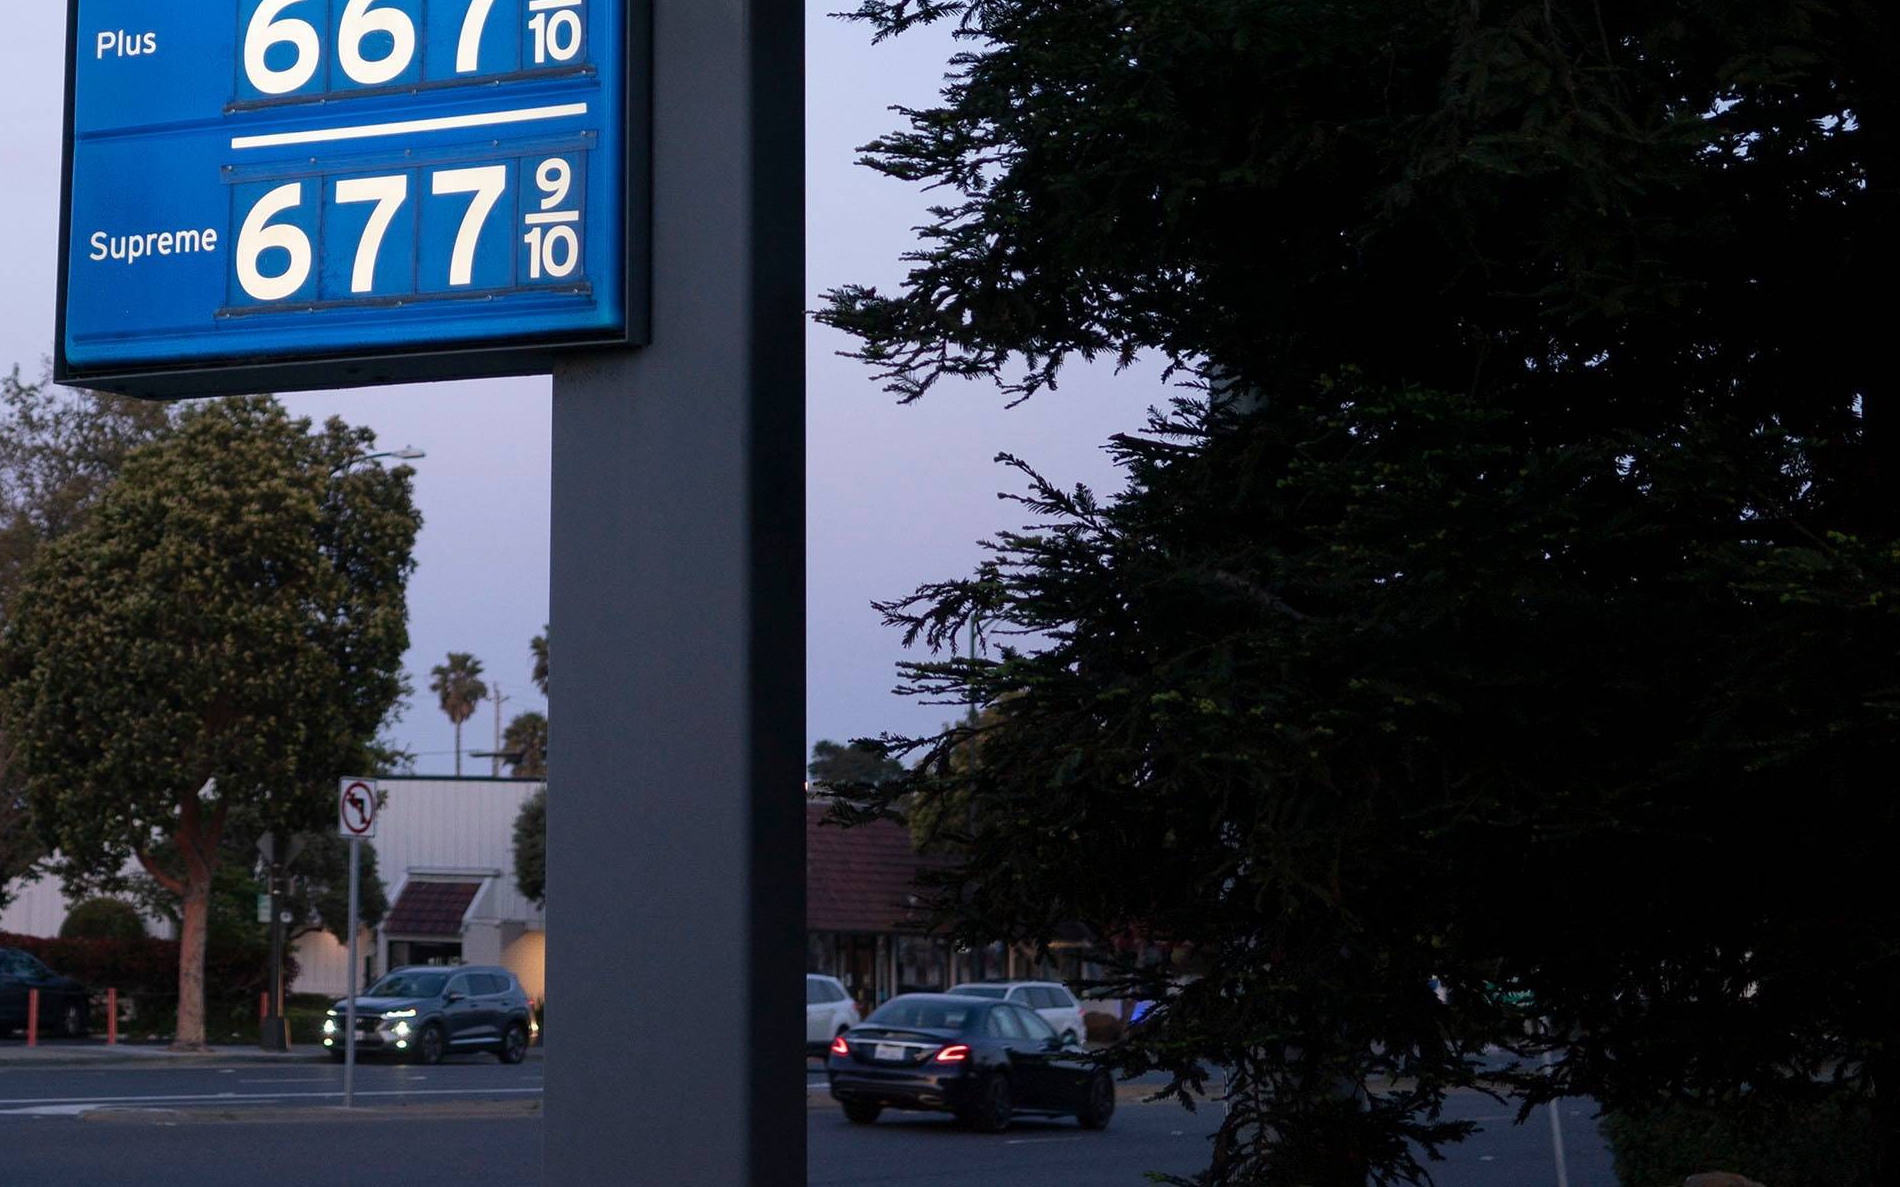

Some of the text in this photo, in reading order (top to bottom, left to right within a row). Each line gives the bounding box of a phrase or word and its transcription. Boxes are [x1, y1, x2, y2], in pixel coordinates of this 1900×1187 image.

[97, 29, 157, 59] Plus
[528, 9, 582, 64] 10
[535, 157, 572, 211] 9
[89, 164, 507, 301] Supreme 677
[523, 224, 579, 279] 10
